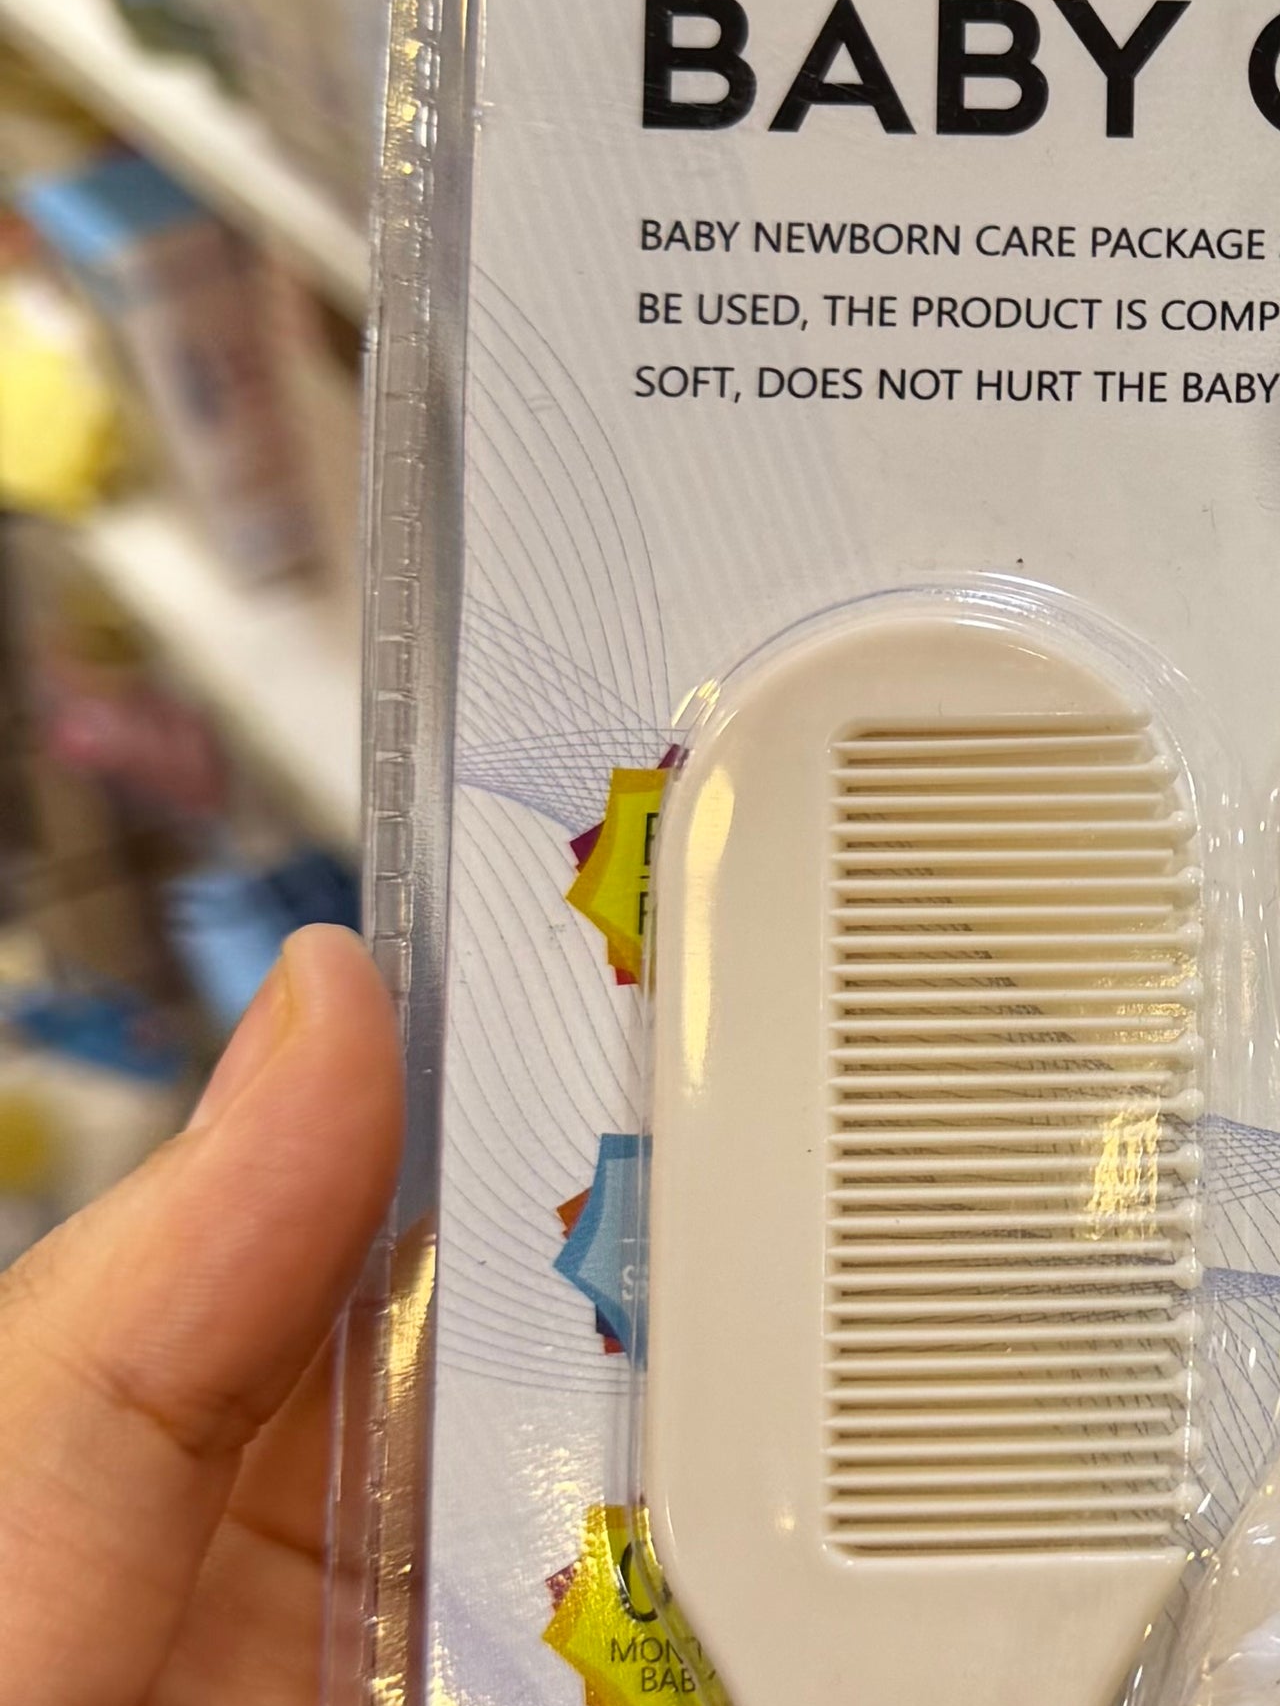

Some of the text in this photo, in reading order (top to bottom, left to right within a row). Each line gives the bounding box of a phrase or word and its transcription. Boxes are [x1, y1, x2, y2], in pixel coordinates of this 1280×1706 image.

[639, 219, 741, 255] BABY
[753, 220, 962, 257] NEWBORN
[975, 223, 1078, 258] CARE
[1090, 226, 1267, 262] PACKAGE
[638, 293, 685, 324] BE
[697, 294, 810, 333] USED,
[823, 296, 897, 327] THE
[911, 297, 1098, 329] PRODUCT
[1117, 299, 1147, 331] IS
[633, 366, 743, 404] SOFT,
[756, 367, 864, 400] DOES
[877, 368, 963, 401] NOT
[974, 369, 1082, 403] HURT
[1093, 371, 1169, 404] THE
